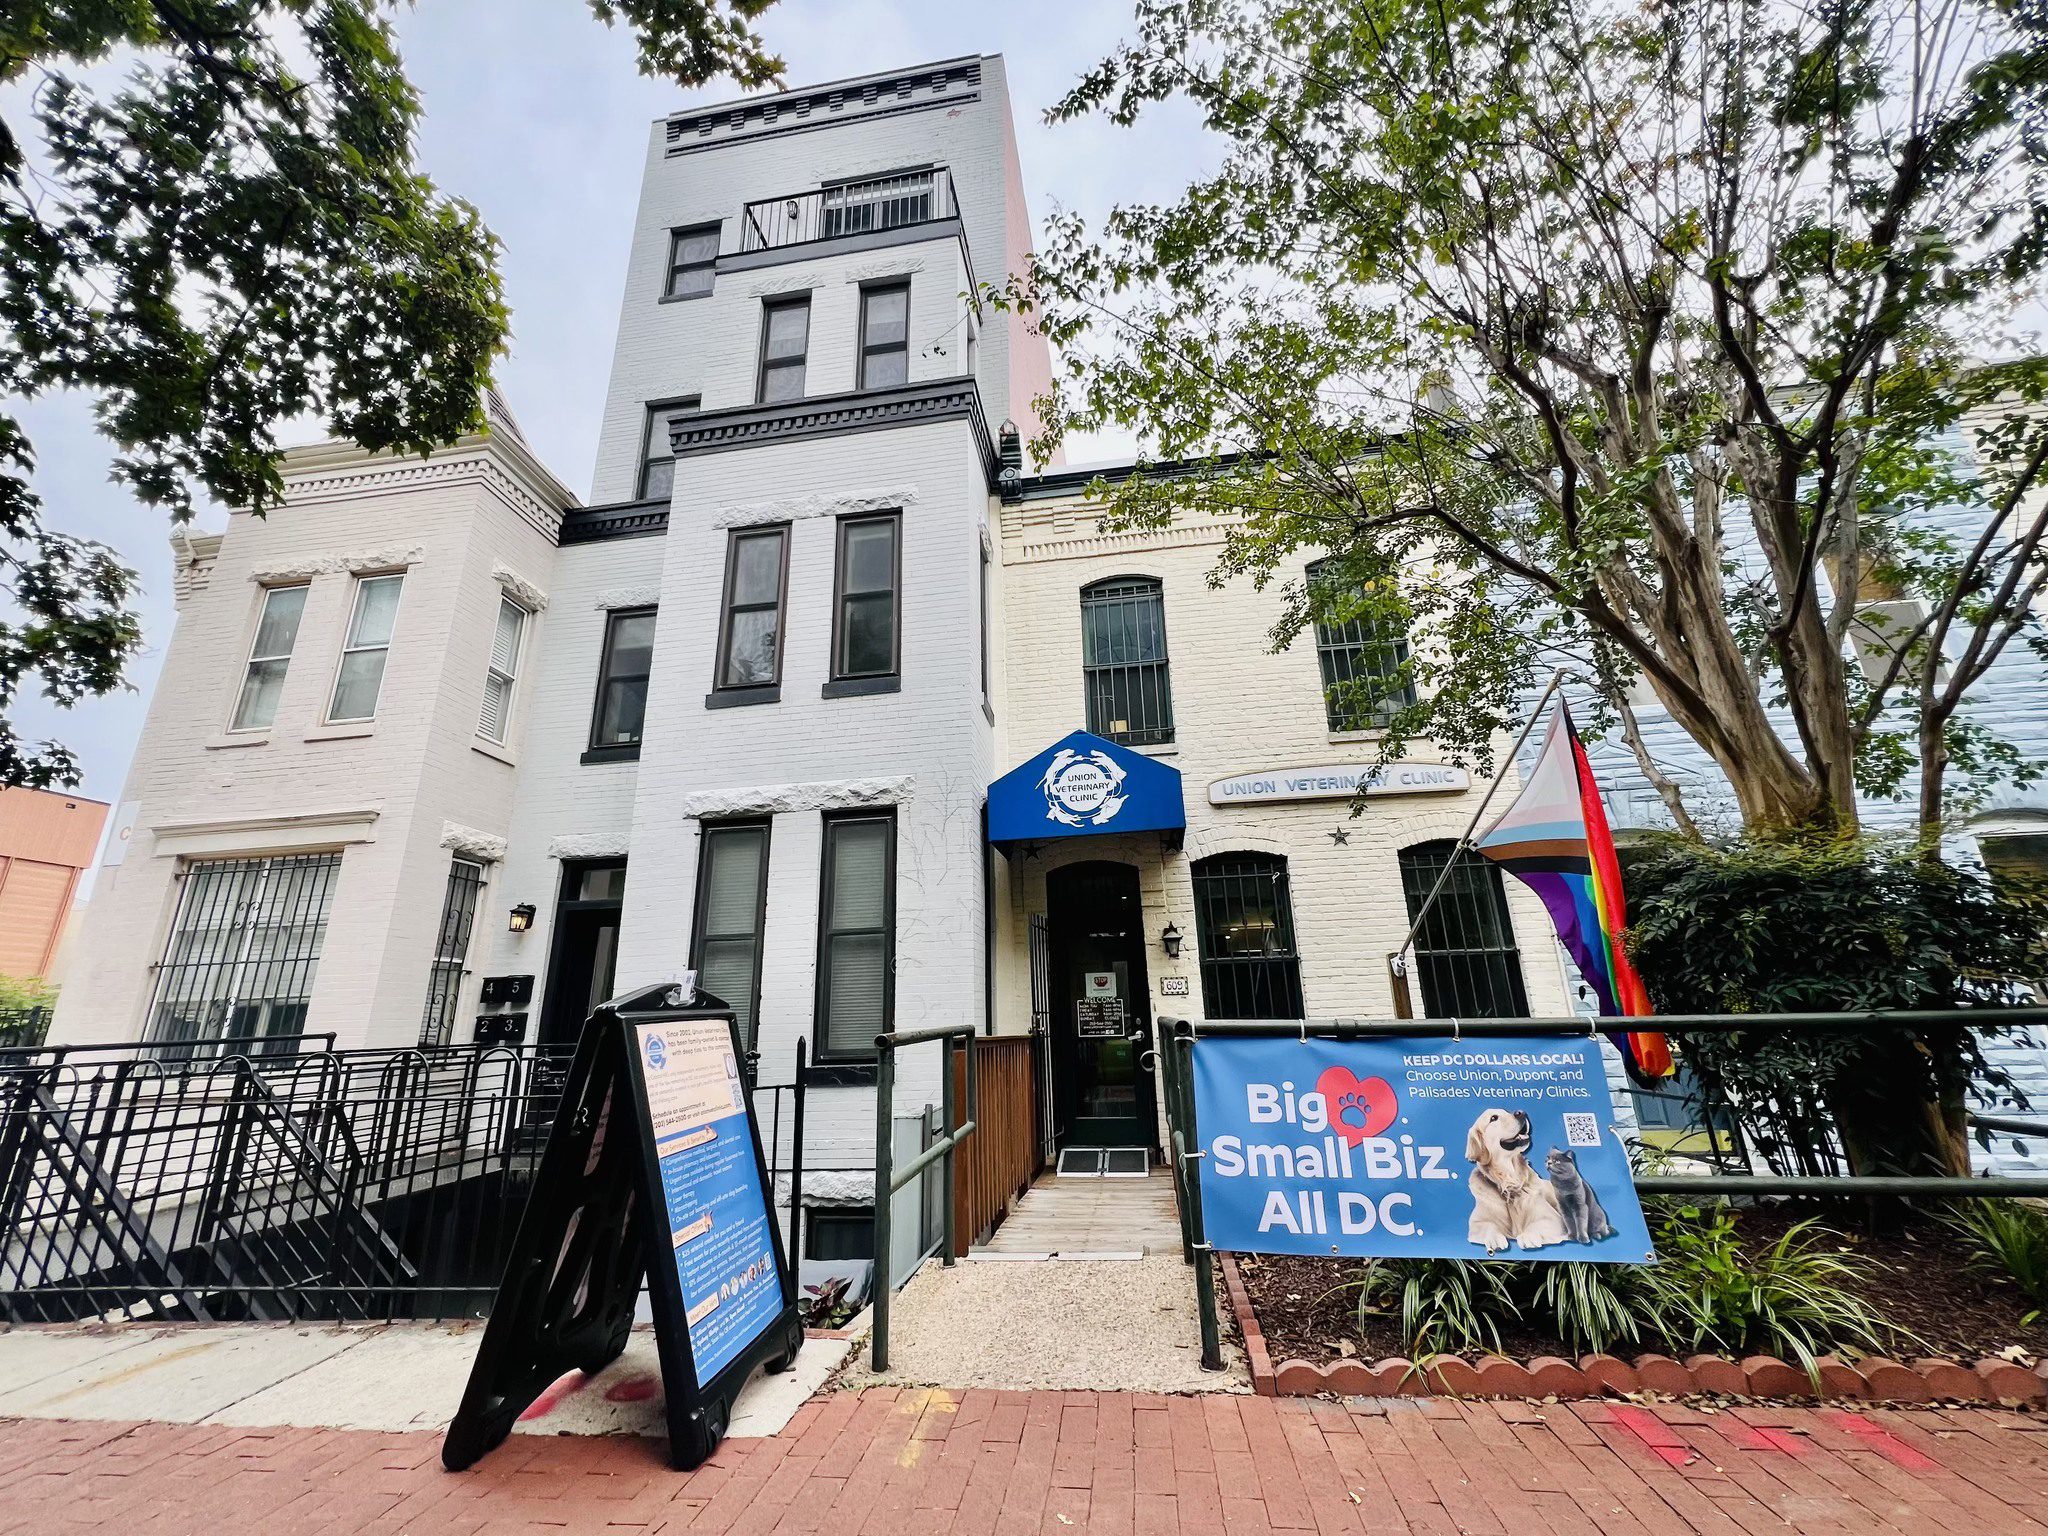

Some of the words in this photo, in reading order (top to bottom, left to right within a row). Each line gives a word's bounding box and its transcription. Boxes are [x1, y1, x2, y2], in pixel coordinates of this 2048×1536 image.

[1067, 773, 1097, 782] UNION
[1223, 780, 1276, 796] UNION
[1399, 770, 1455, 785] CLINIC
[1055, 782, 1110, 793] VETERINARY
[1069, 793, 1098, 802] CLINIC
[485, 982, 494, 994] 4
[511, 981, 520, 993] 5
[1166, 980, 1183, 991] 609
[480, 1020, 489, 1032] 2
[1403, 1055, 1440, 1067] KEEP
[1443, 1055, 1463, 1066] DC
[1464, 1054, 1531, 1066] DOLLARS
[1533, 1053, 1585, 1065] LOCAL!
[1406, 1070, 1457, 1082] Choose
[1459, 1070, 1502, 1083] Union,
[1504, 1069, 1558, 1083] Dupont,
[1559, 1069, 1584, 1081] and
[1409, 1086, 1470, 1098] Palisades
[1471, 1086, 1544, 1100] Veterinary
[1546, 1086, 1592, 1098] Clinics.
[1247, 1081, 1328, 1133] Big
[1211, 1135, 1353, 1179] Small
[1362, 1134, 1459, 1180] Biz.
[1257, 1190, 1328, 1235] All
[1337, 1191, 1424, 1237] DC.
